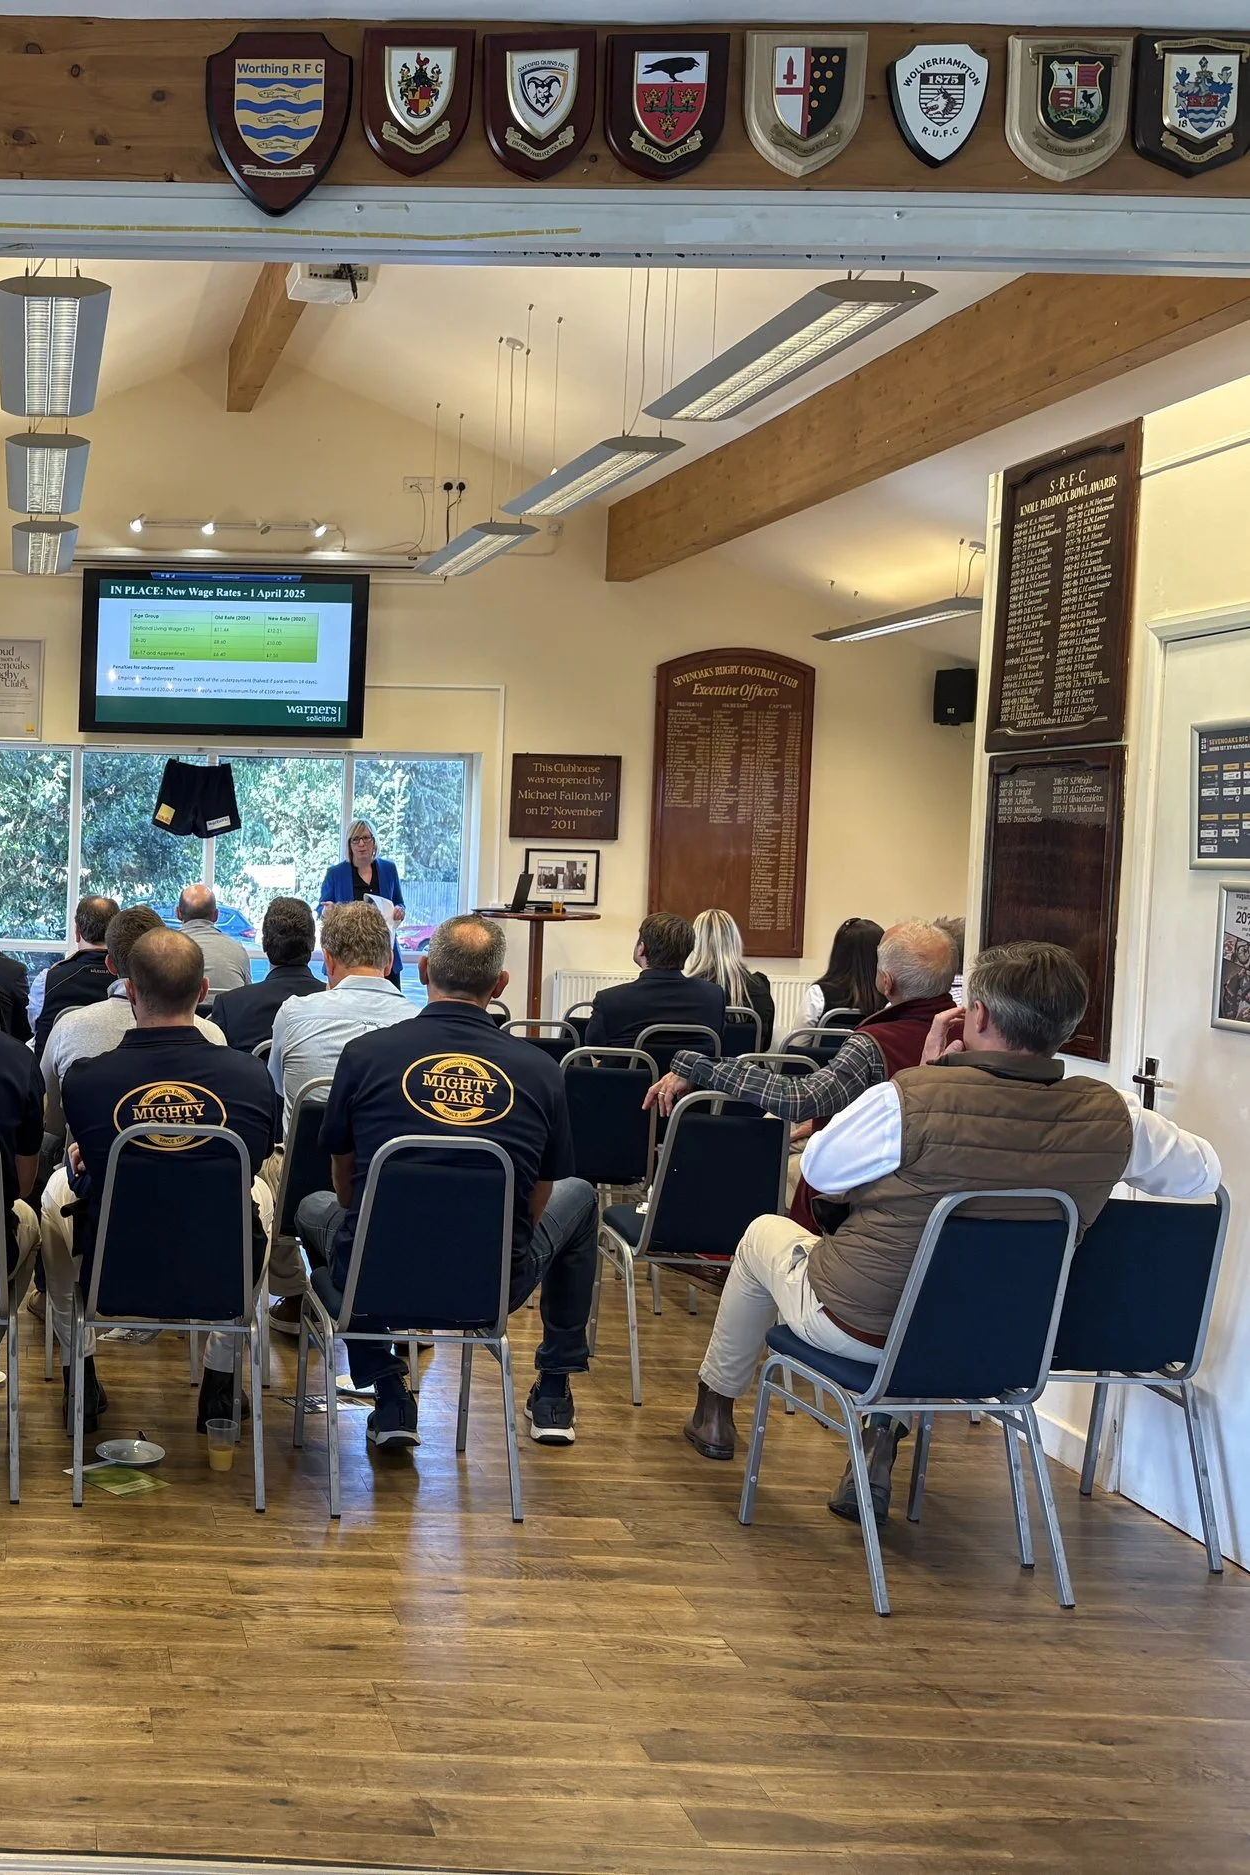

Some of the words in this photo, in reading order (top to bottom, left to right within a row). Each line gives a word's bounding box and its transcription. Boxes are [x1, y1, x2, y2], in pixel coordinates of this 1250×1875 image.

[237, 63, 289, 75] Worthing
[292, 63, 301, 73] R
[304, 63, 311, 73] F
[315, 63, 323, 73] C
[517, 61, 540, 73] OXFORD
[558, 62, 569, 70] RFC
[903, 57, 981, 87] WOLVERHAMPTON
[928, 75, 959, 84] 1875
[1178, 120, 1188, 128] 18
[1215, 120, 1226, 128] 70
[921, 126, 959, 138] R.U.F.C
[511, 140, 531, 153] OXFORD
[640, 145, 679, 161] COLCHESTER
[680, 144, 693, 156] RFC
[1019, 501, 1039, 517] KNOLE
[1040, 491, 1070, 510] PADDOCK
[1070, 485, 1088, 500] BOWL
[1088, 474, 1117, 494] AWARDS
[110, 586, 122, 594] IN
[125, 586, 163, 595] PLACE:
[166, 587, 186, 596] New
[188, 588, 213, 598] Wage
[216, 588, 241, 597] Rates
[257, 589, 282, 599] April
[284, 590, 306, 598] 2025
[672, 667, 714, 687] SEVENOAKS
[715, 665, 740, 676] RUGBY
[740, 665, 778, 681] FOOTBALL
[778, 674, 799, 689] CLUB
[692, 683, 739, 696] Executive
[739, 683, 780, 702] Officers
[286, 705, 337, 715] warners
[533, 763, 553, 772] This
[553, 763, 601, 773] Clubhouse
[527, 776, 545, 784] was
[546, 776, 590, 787] reopened
[592, 776, 605, 788] by
[517, 788, 557, 800] Michael
[594, 792, 612, 801] MP
[525, 807, 538, 815] on
[553, 806, 603, 817] November
[551, 819, 576, 830] 2011
[436, 1061, 468, 1073] Sevenoaks
[421, 1073, 498, 1094] MIGHTY
[144, 1089, 173, 1105] Sevenoaks
[173, 1090, 191, 1102] Rugby
[433, 1088, 485, 1106] OAKS
[132, 1103, 206, 1121] MIGHTY
[442, 1108, 459, 1118] SINCE
